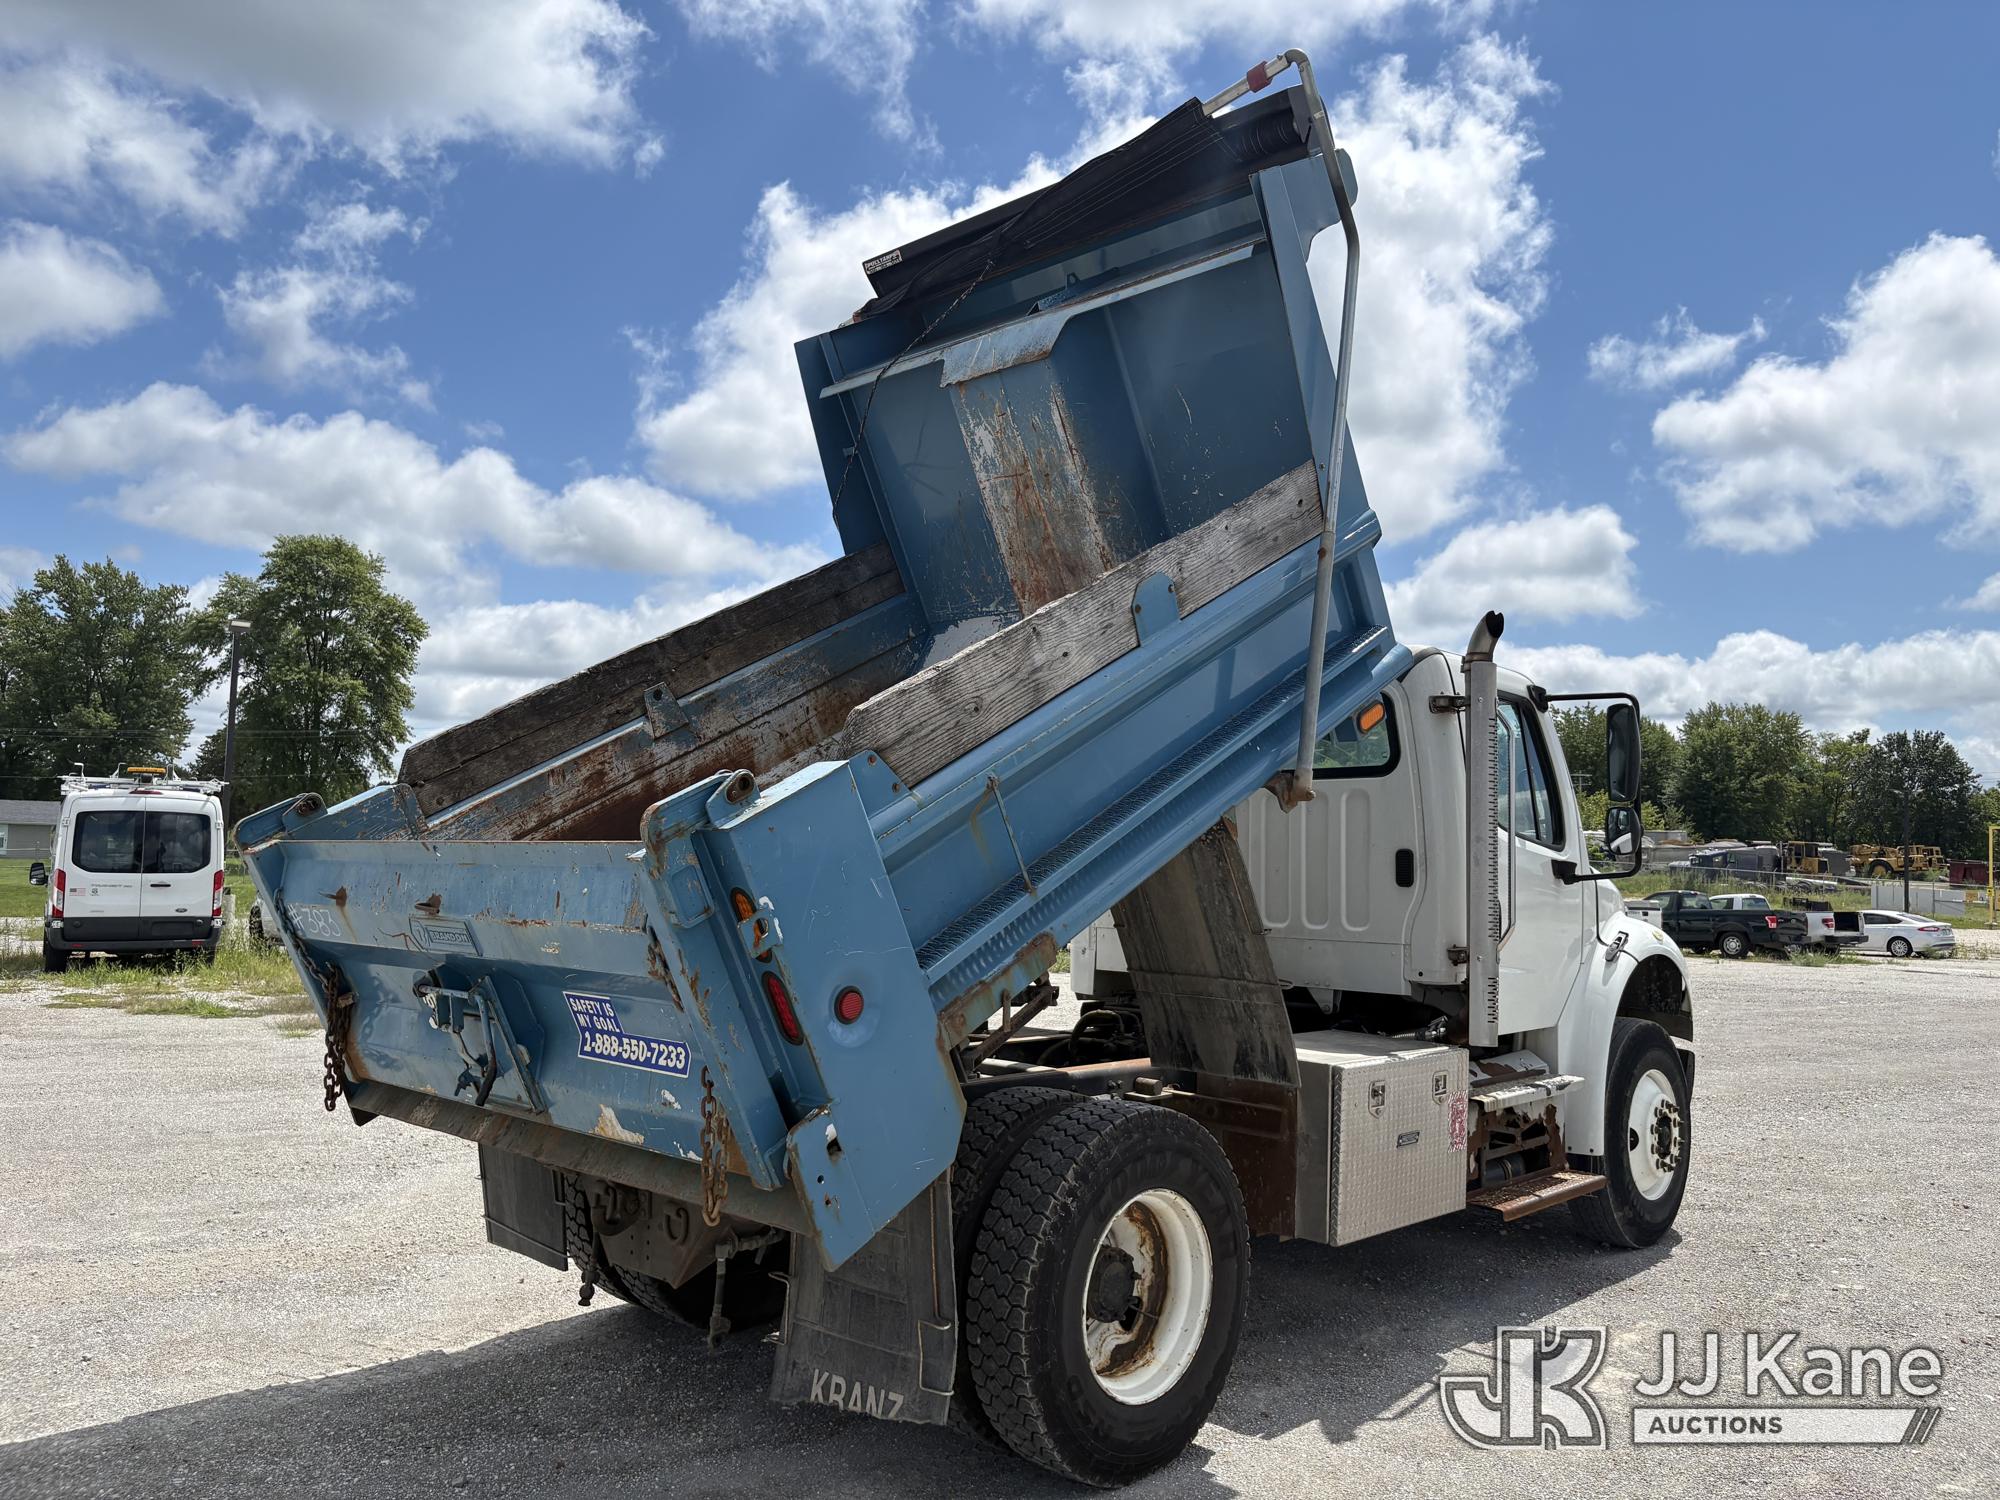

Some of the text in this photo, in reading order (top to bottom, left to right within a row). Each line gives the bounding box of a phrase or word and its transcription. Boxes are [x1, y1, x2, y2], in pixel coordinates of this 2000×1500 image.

[288, 904, 341, 937] #383
[570, 998, 615, 1017] SAFETY IS
[576, 1014, 620, 1032] MY GOAL
[583, 1031, 686, 1070] 1-888-550-7233
[810, 1369, 904, 1419] KRANZ
